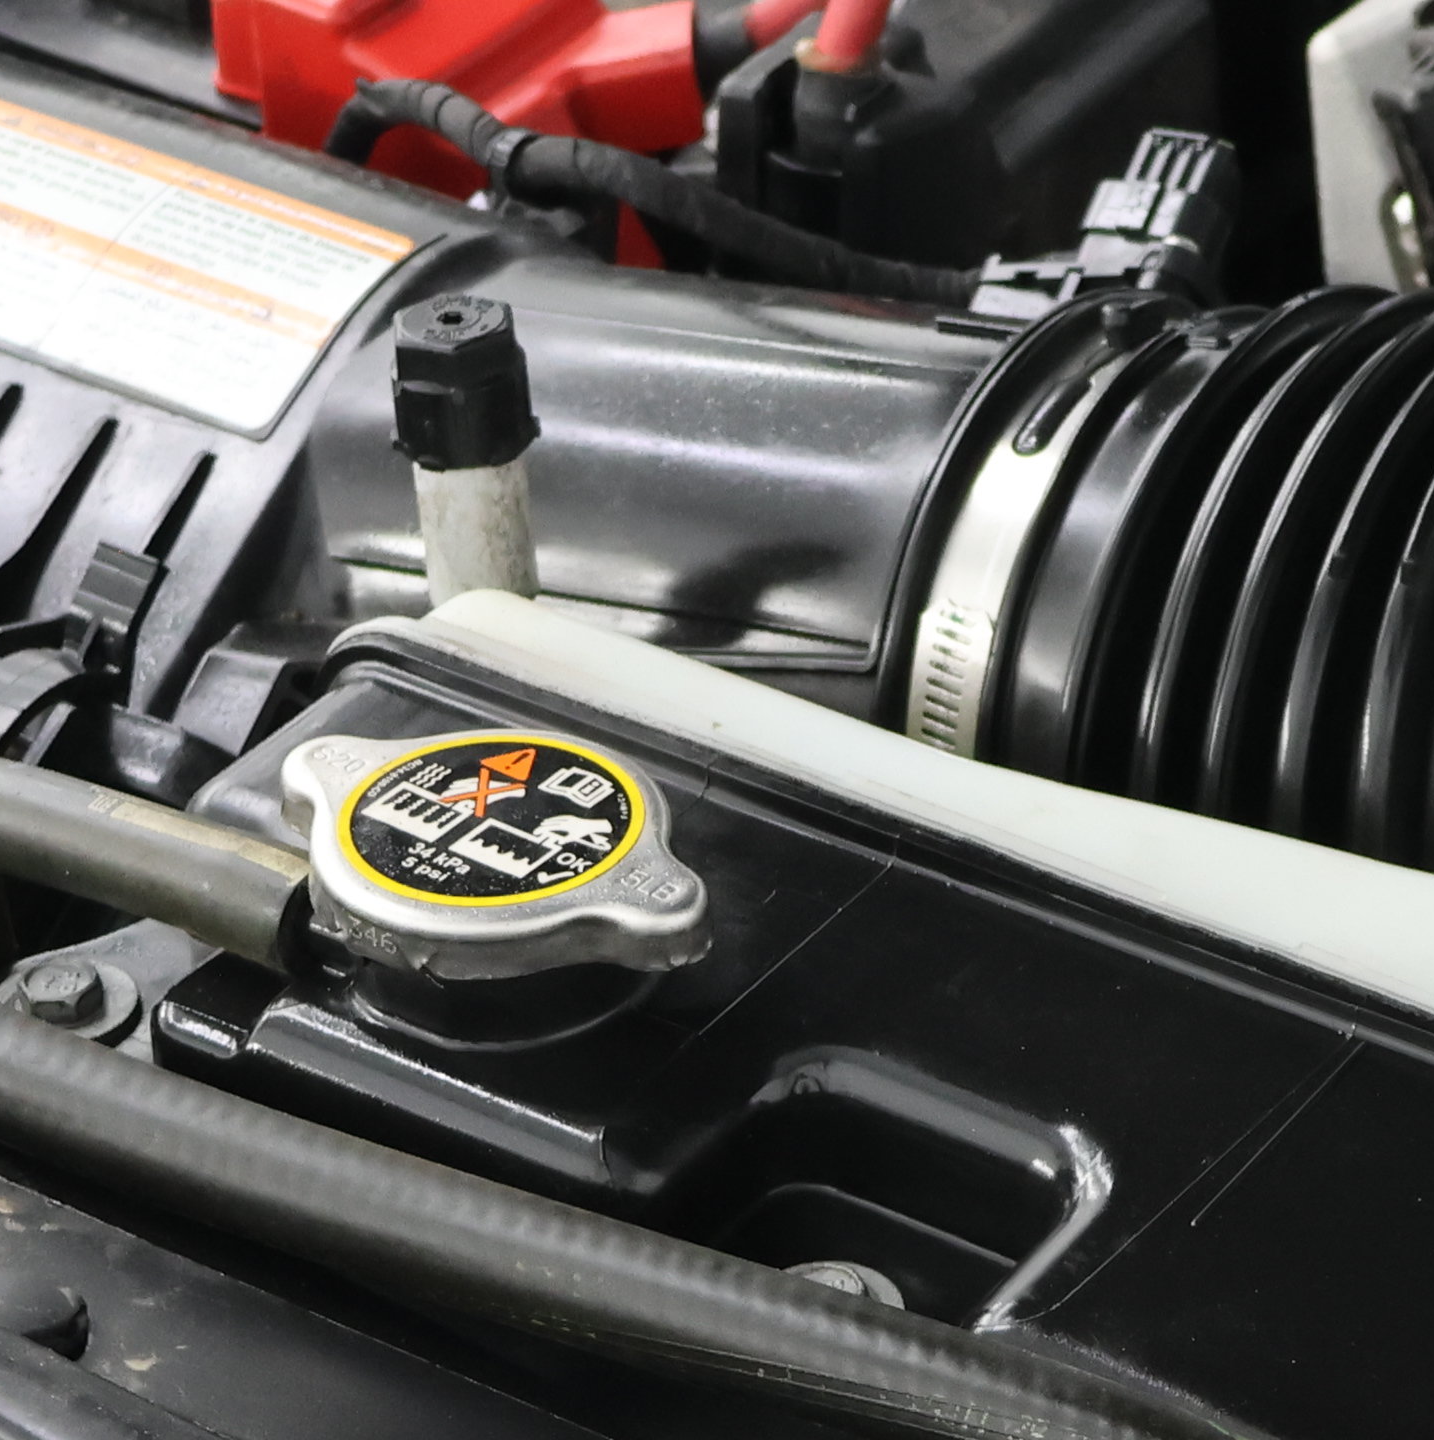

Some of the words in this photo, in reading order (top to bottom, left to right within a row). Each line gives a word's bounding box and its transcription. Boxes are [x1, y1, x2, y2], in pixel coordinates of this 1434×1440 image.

[401, 856, 420, 868] 5
[415, 864, 451, 882] psi
[408, 842, 436, 859] 34
[433, 852, 471, 875] kPa
[556, 852, 593, 873] OK
[619, 868, 679, 901] 5LB
[348, 914, 397, 955] 346
